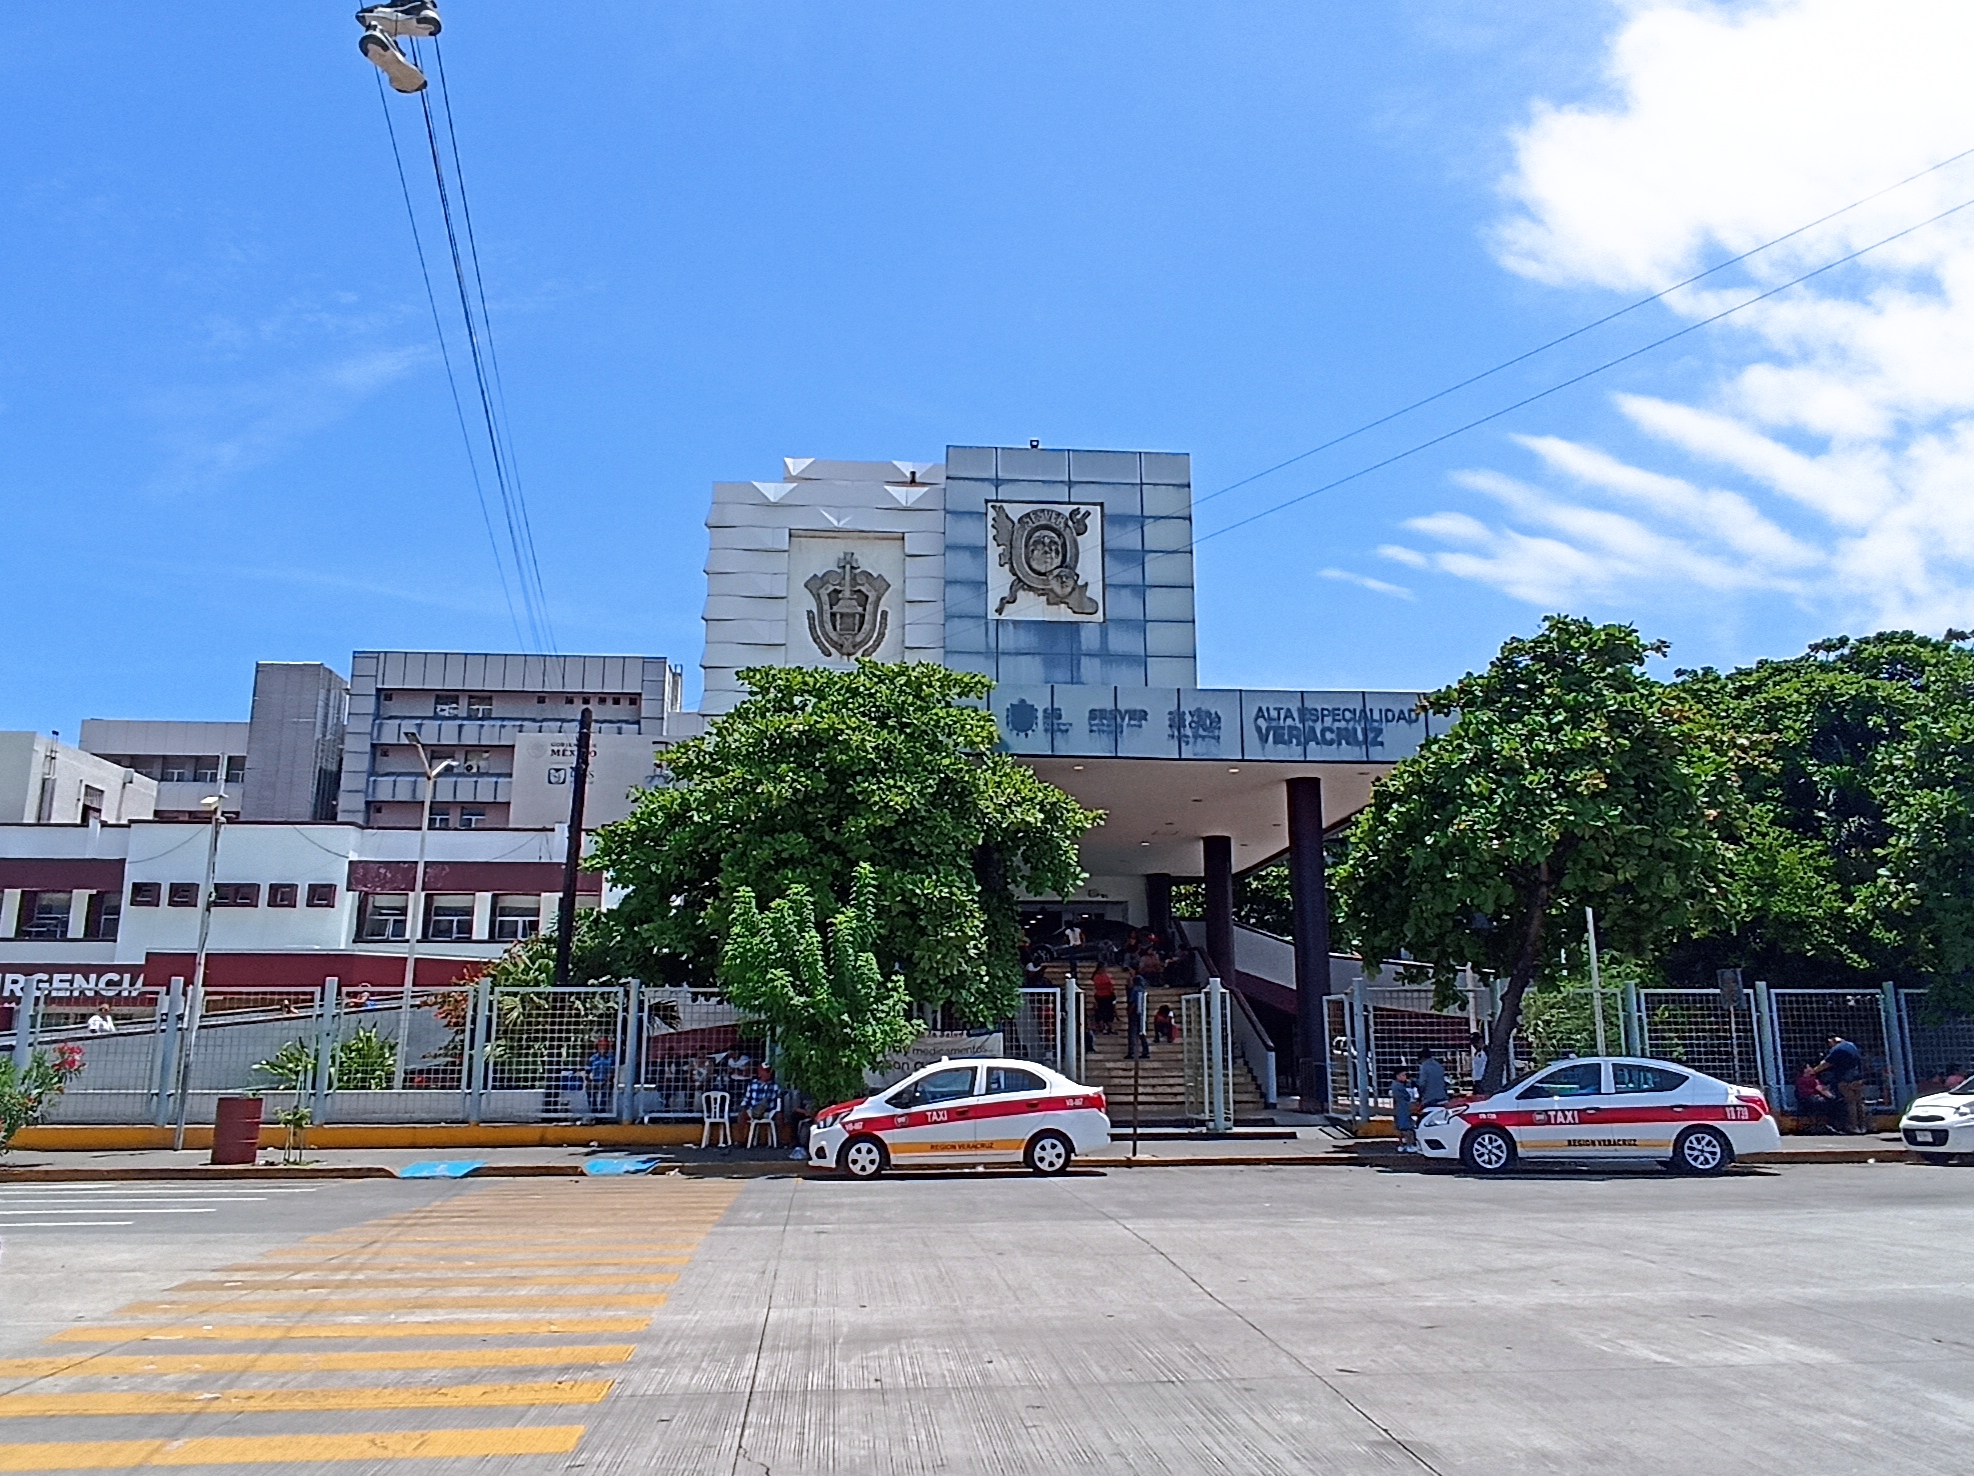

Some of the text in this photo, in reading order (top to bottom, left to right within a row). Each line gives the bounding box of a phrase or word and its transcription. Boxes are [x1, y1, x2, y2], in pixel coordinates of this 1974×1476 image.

[1254, 706, 1419, 723] ALTA ESPECIALIDAD
[1255, 725, 1384, 746] VERACRUZ
[926, 1110, 948, 1122] TAXI
[1548, 1111, 1579, 1123] TAXI
